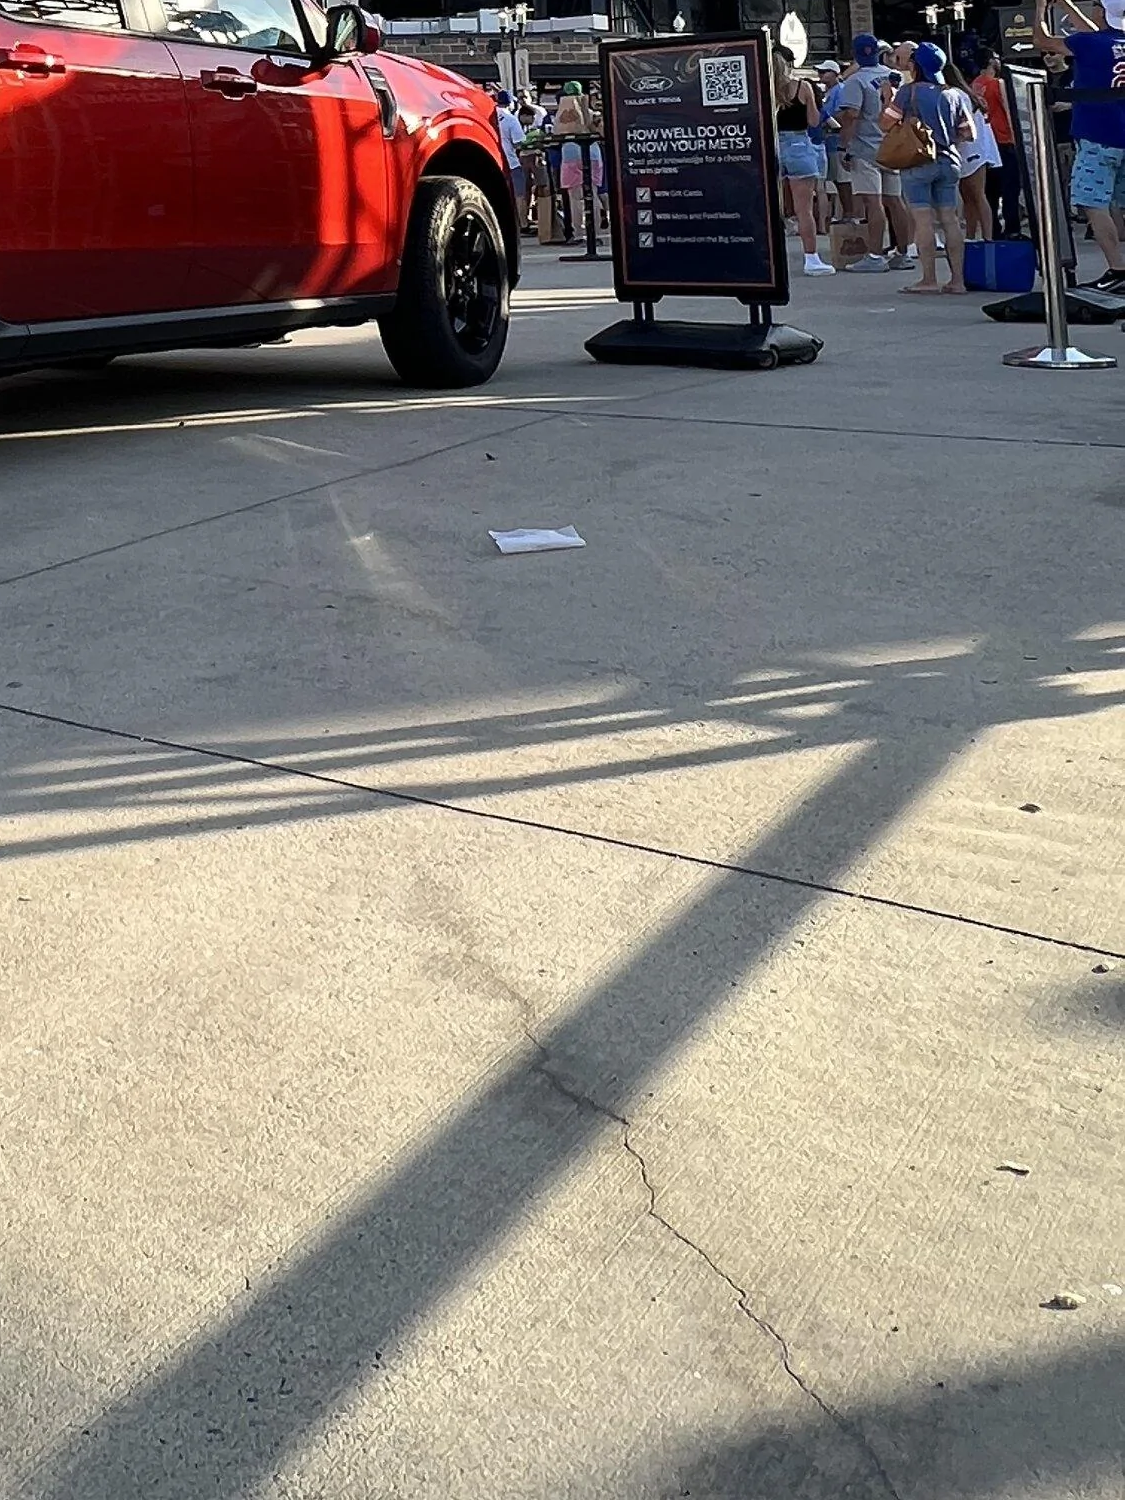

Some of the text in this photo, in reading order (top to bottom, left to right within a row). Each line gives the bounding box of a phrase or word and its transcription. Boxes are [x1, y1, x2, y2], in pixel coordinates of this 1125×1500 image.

[626, 124, 747, 141] HOW WELL DO YOU
[627, 137, 753, 154] KNOW YOUR METS?
